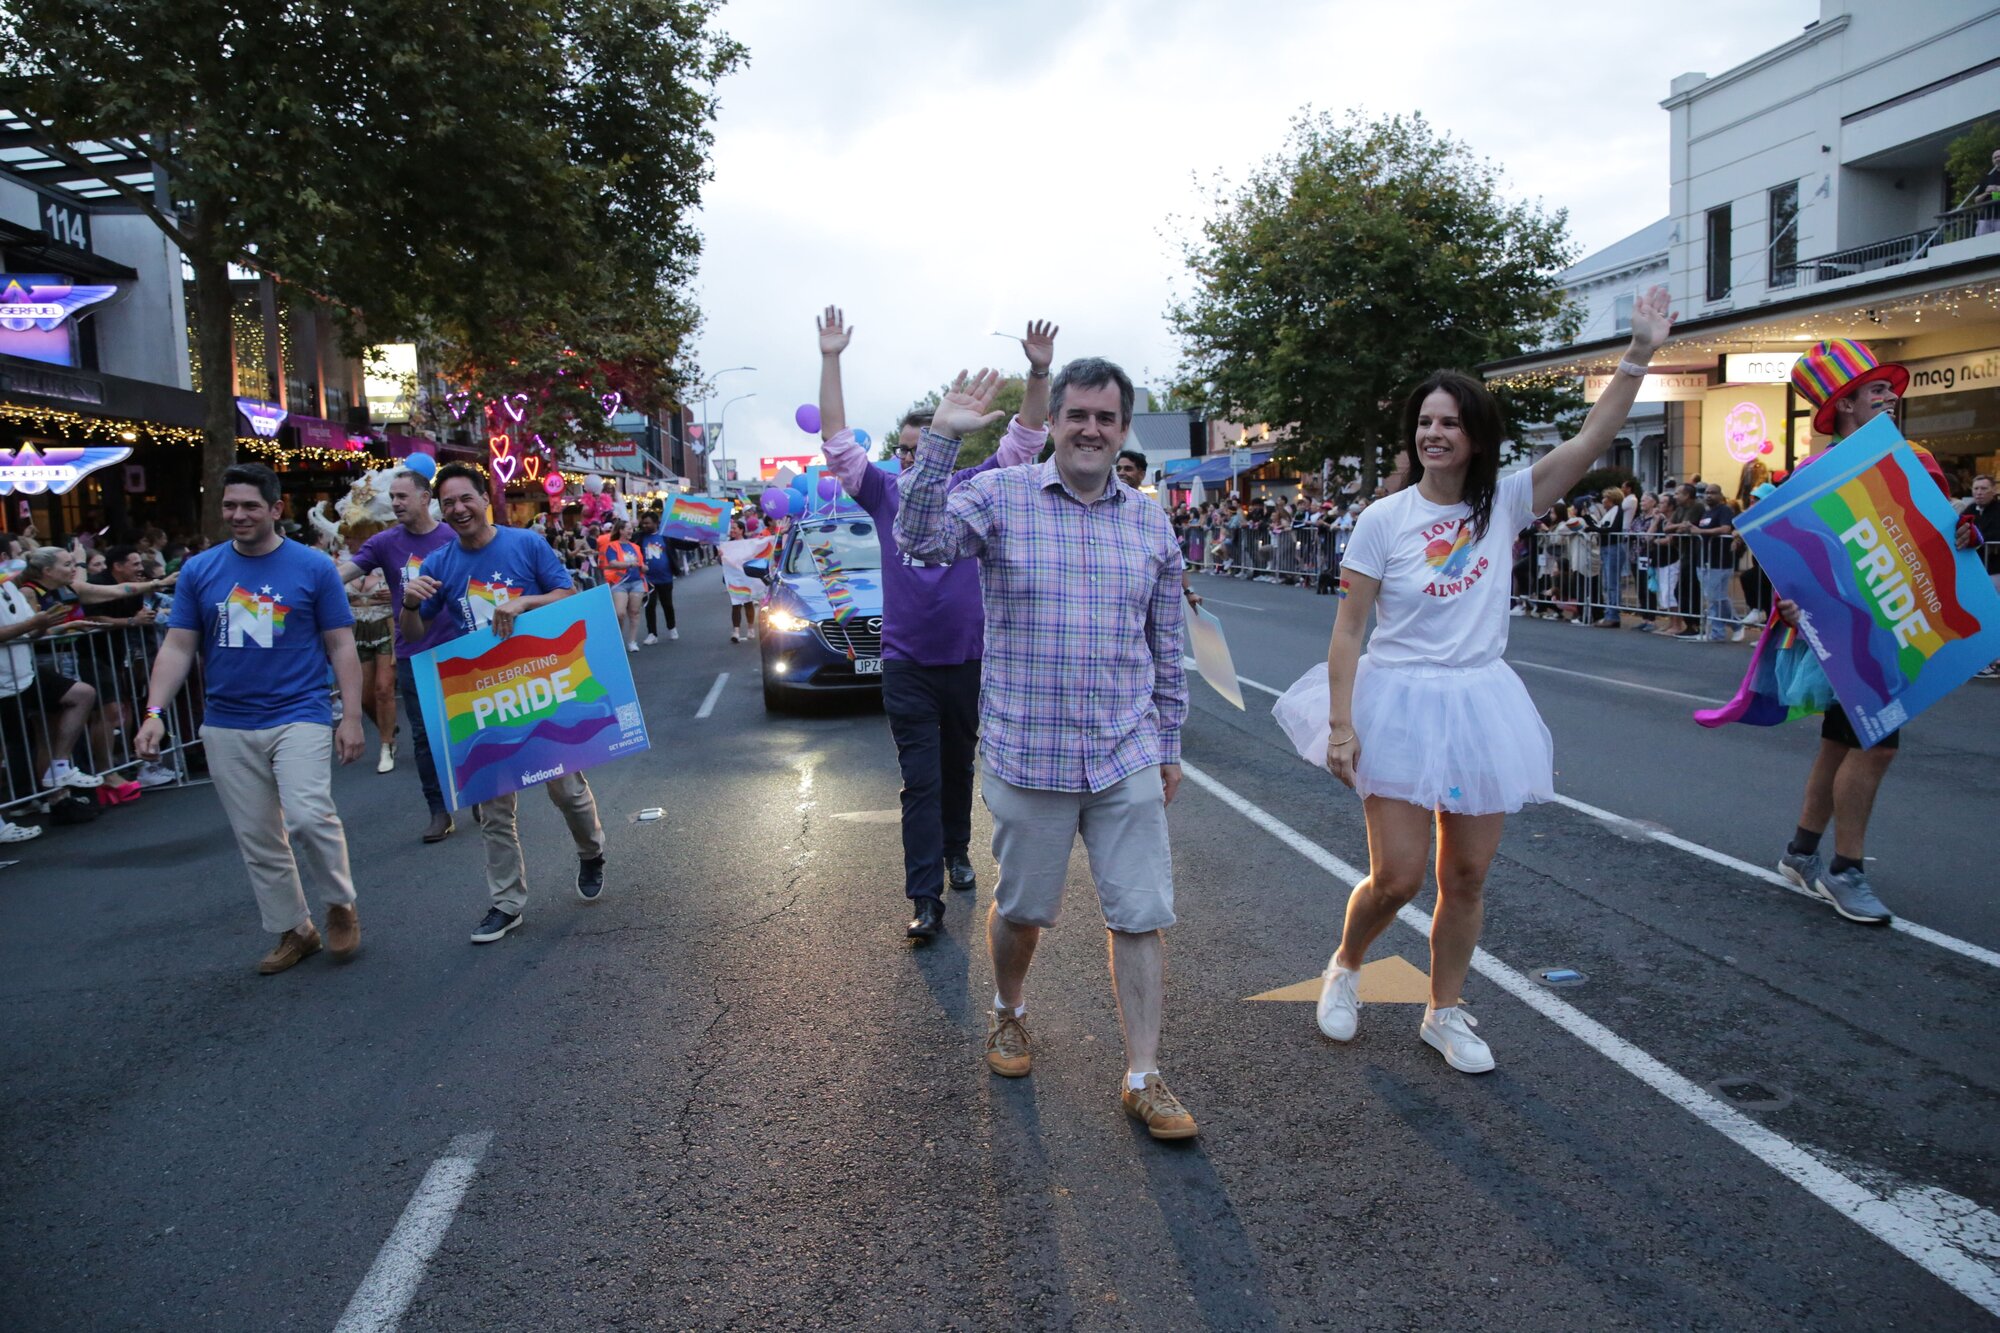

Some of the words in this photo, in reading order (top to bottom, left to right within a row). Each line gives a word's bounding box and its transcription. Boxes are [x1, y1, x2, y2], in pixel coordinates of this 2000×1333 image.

[46, 203, 86, 250] 114
[1655, 377, 1705, 388] ECYCLE
[1748, 360, 1787, 379] mag
[1913, 368, 1955, 389] mag
[548, 479, 561, 488] 40
[679, 511, 712, 526] PRIDE
[1422, 556, 1489, 597] ALWAYS
[1838, 517, 1932, 650] PRIDE
[1881, 515, 1942, 614] CELEBRATING
[215, 602, 228, 648] National
[475, 653, 558, 691] CELEBRATING
[471, 667, 577, 730] PRIDE
[521, 763, 564, 786] National
